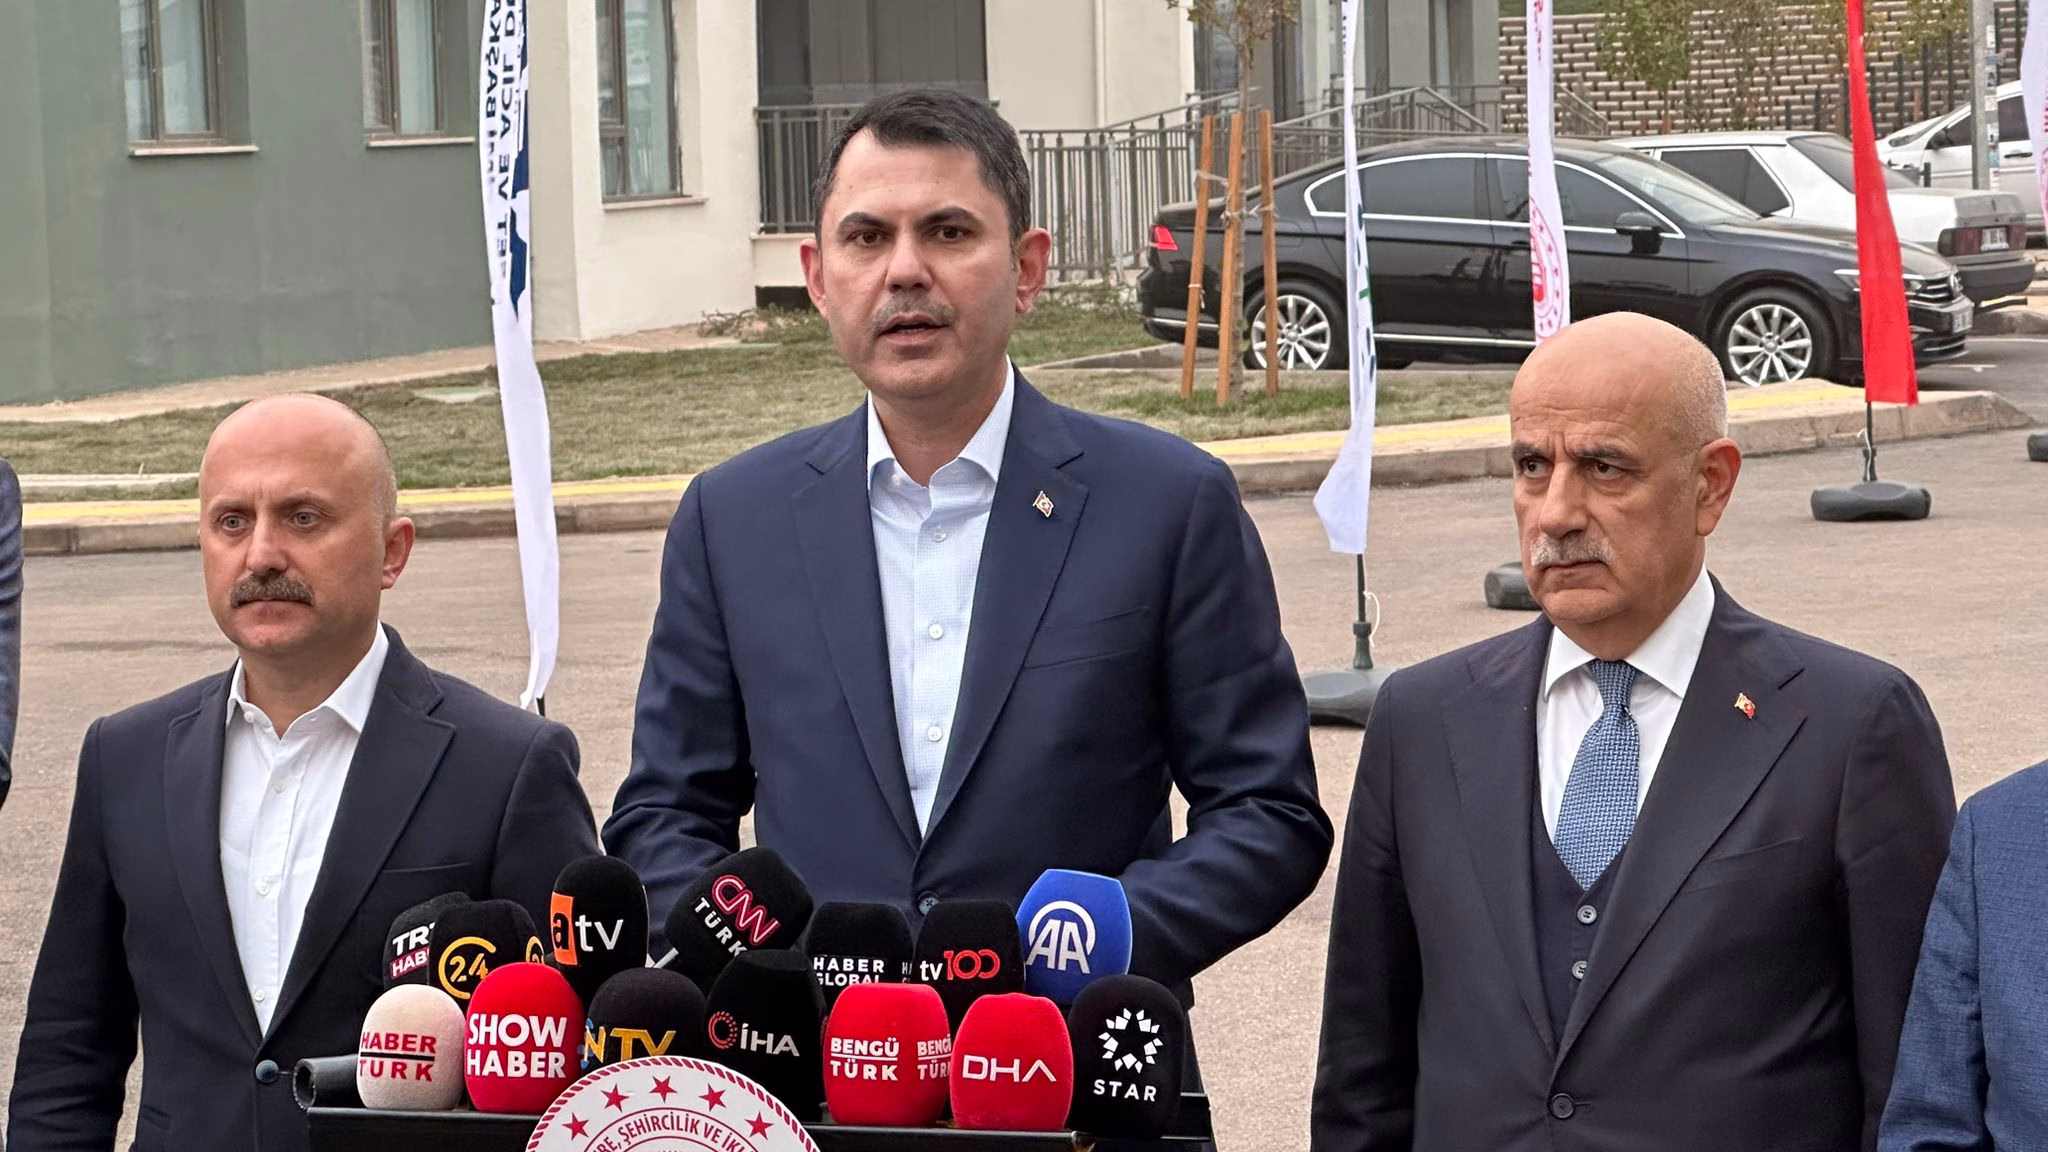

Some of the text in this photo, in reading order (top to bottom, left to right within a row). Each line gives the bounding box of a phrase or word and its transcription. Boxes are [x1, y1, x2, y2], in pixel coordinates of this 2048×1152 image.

[711, 873, 781, 947] CNN
[392, 921, 436, 957] TR
[552, 910, 624, 952] atv
[692, 897, 748, 957] TÜRK
[1025, 918, 1091, 974] AA
[391, 948, 430, 977] HAB
[449, 953, 489, 983] 24
[813, 957, 885, 973] HABER
[920, 948, 1000, 982] tv100
[361, 1031, 437, 1054] HABER
[467, 1013, 568, 1048] SHOW
[584, 1025, 676, 1064] NTV
[739, 1022, 801, 1056] İHA
[830, 1037, 900, 1057] BENGÜ
[359, 1059, 434, 1082] TURK
[466, 1048, 567, 1079] HABER
[829, 1059, 898, 1081] TÜRK
[962, 1054, 1057, 1083] DHA
[1092, 1079, 1157, 1102] STAR
[617, 1110, 702, 1140] ŞEHİRCİLİK
[703, 1122, 723, 1144] VE
